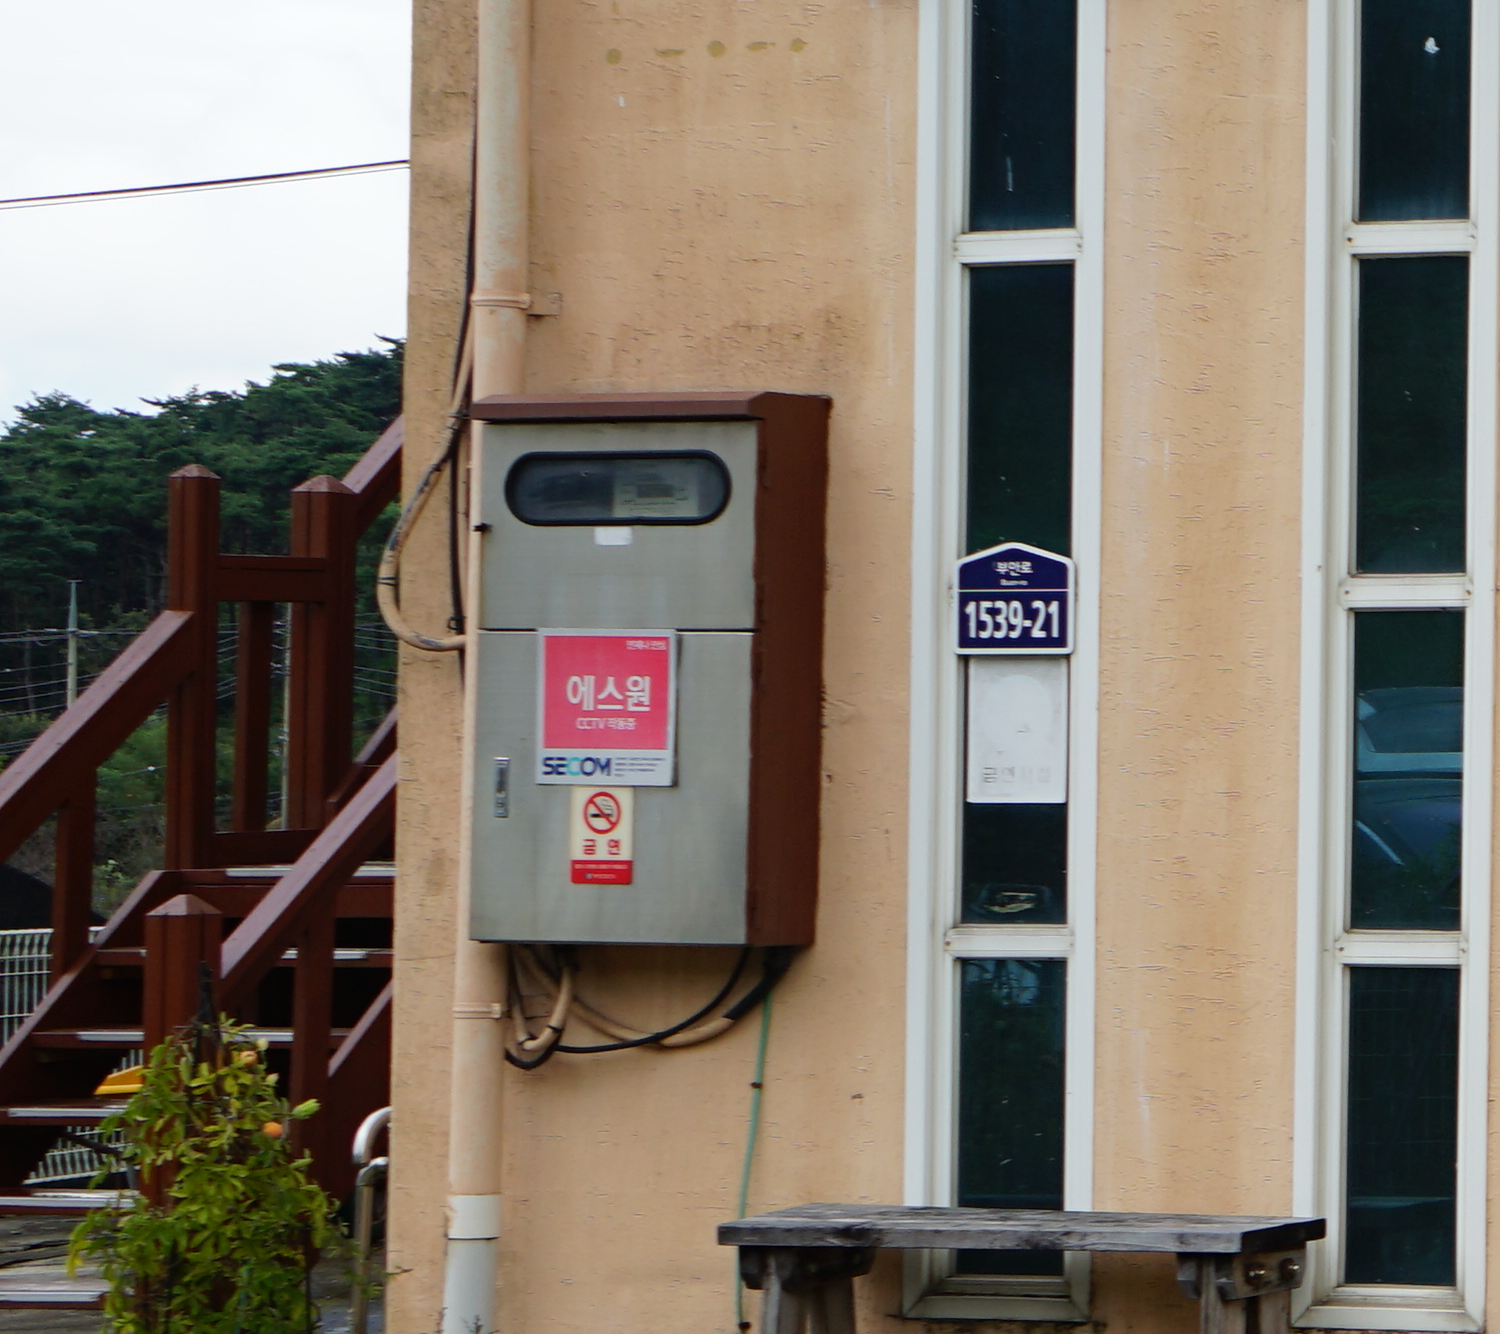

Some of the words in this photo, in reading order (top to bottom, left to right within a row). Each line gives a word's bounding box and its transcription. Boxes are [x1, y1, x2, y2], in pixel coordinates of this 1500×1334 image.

[964, 600, 1060, 639] 1539-21
[566, 675, 651, 712] 에스원
[576, 717, 605, 730] CCTV
[542, 756, 612, 777] SECOM
[583, 839, 621, 855] 금연
